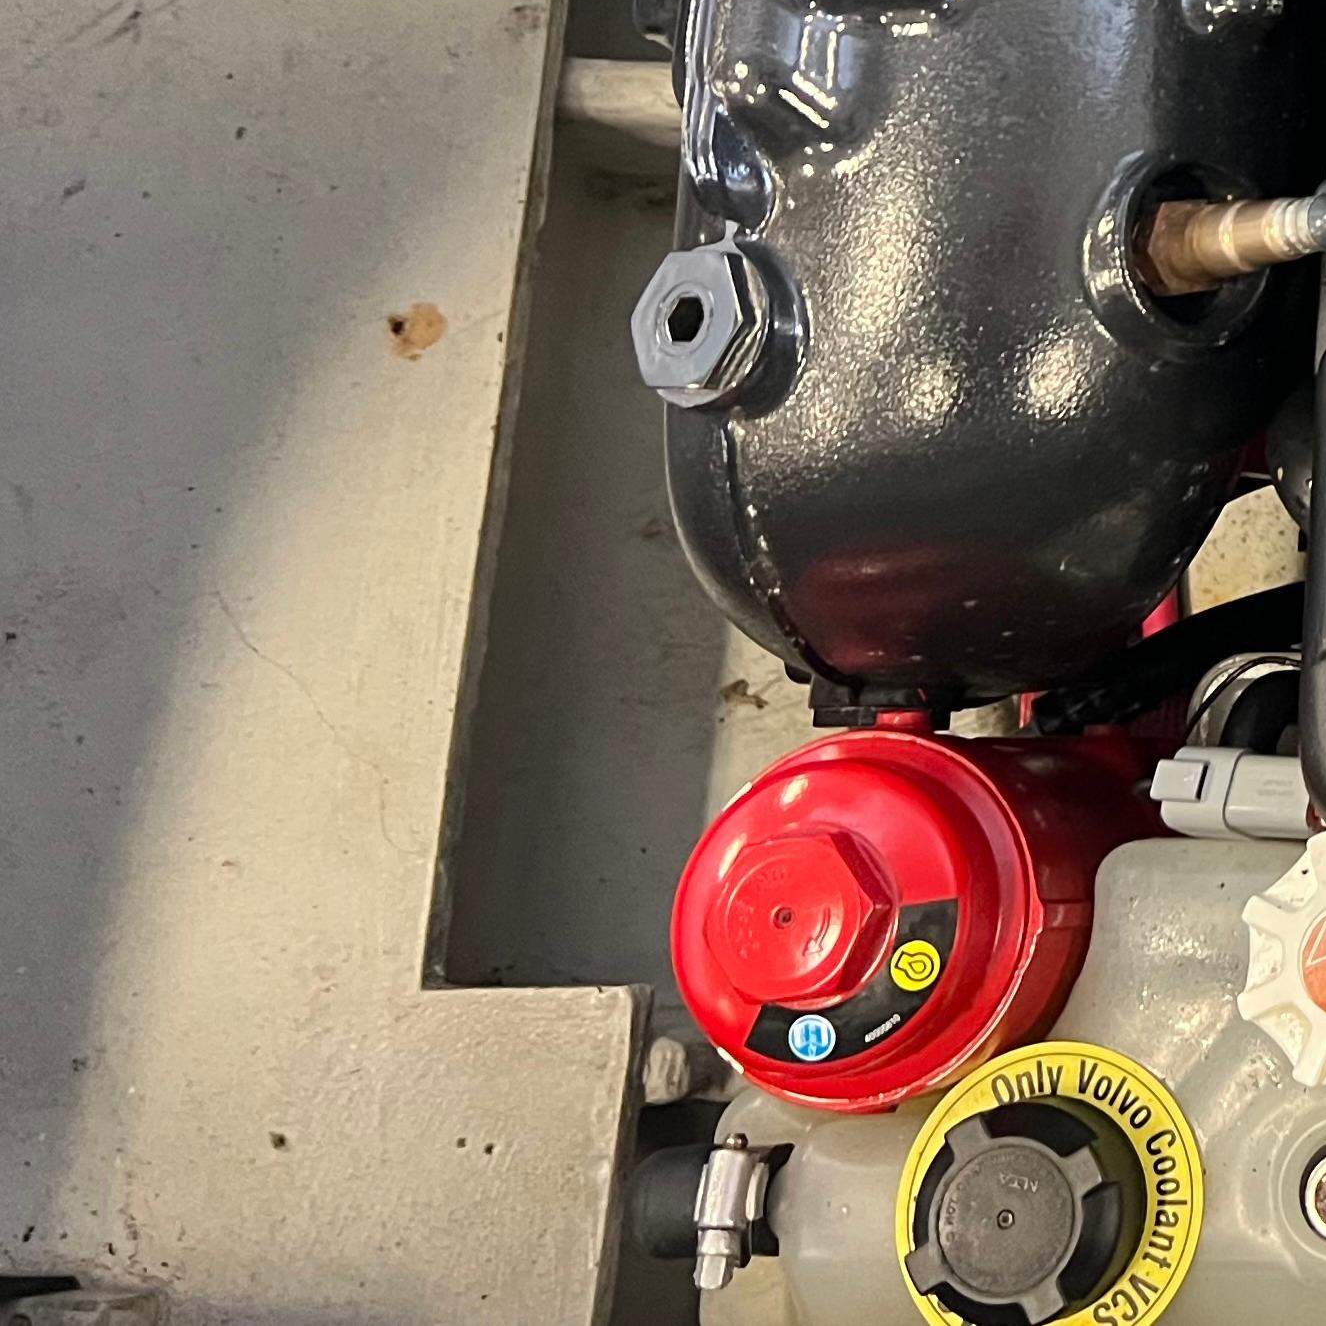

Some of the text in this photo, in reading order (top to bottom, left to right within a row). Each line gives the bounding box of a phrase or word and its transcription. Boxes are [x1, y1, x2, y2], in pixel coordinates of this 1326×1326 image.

[990, 1059, 1064, 1106] Only
[1076, 1058, 1153, 1130] Volvo
[1143, 1128, 1189, 1271] Coolant
[1092, 1272, 1161, 1326] VCS
